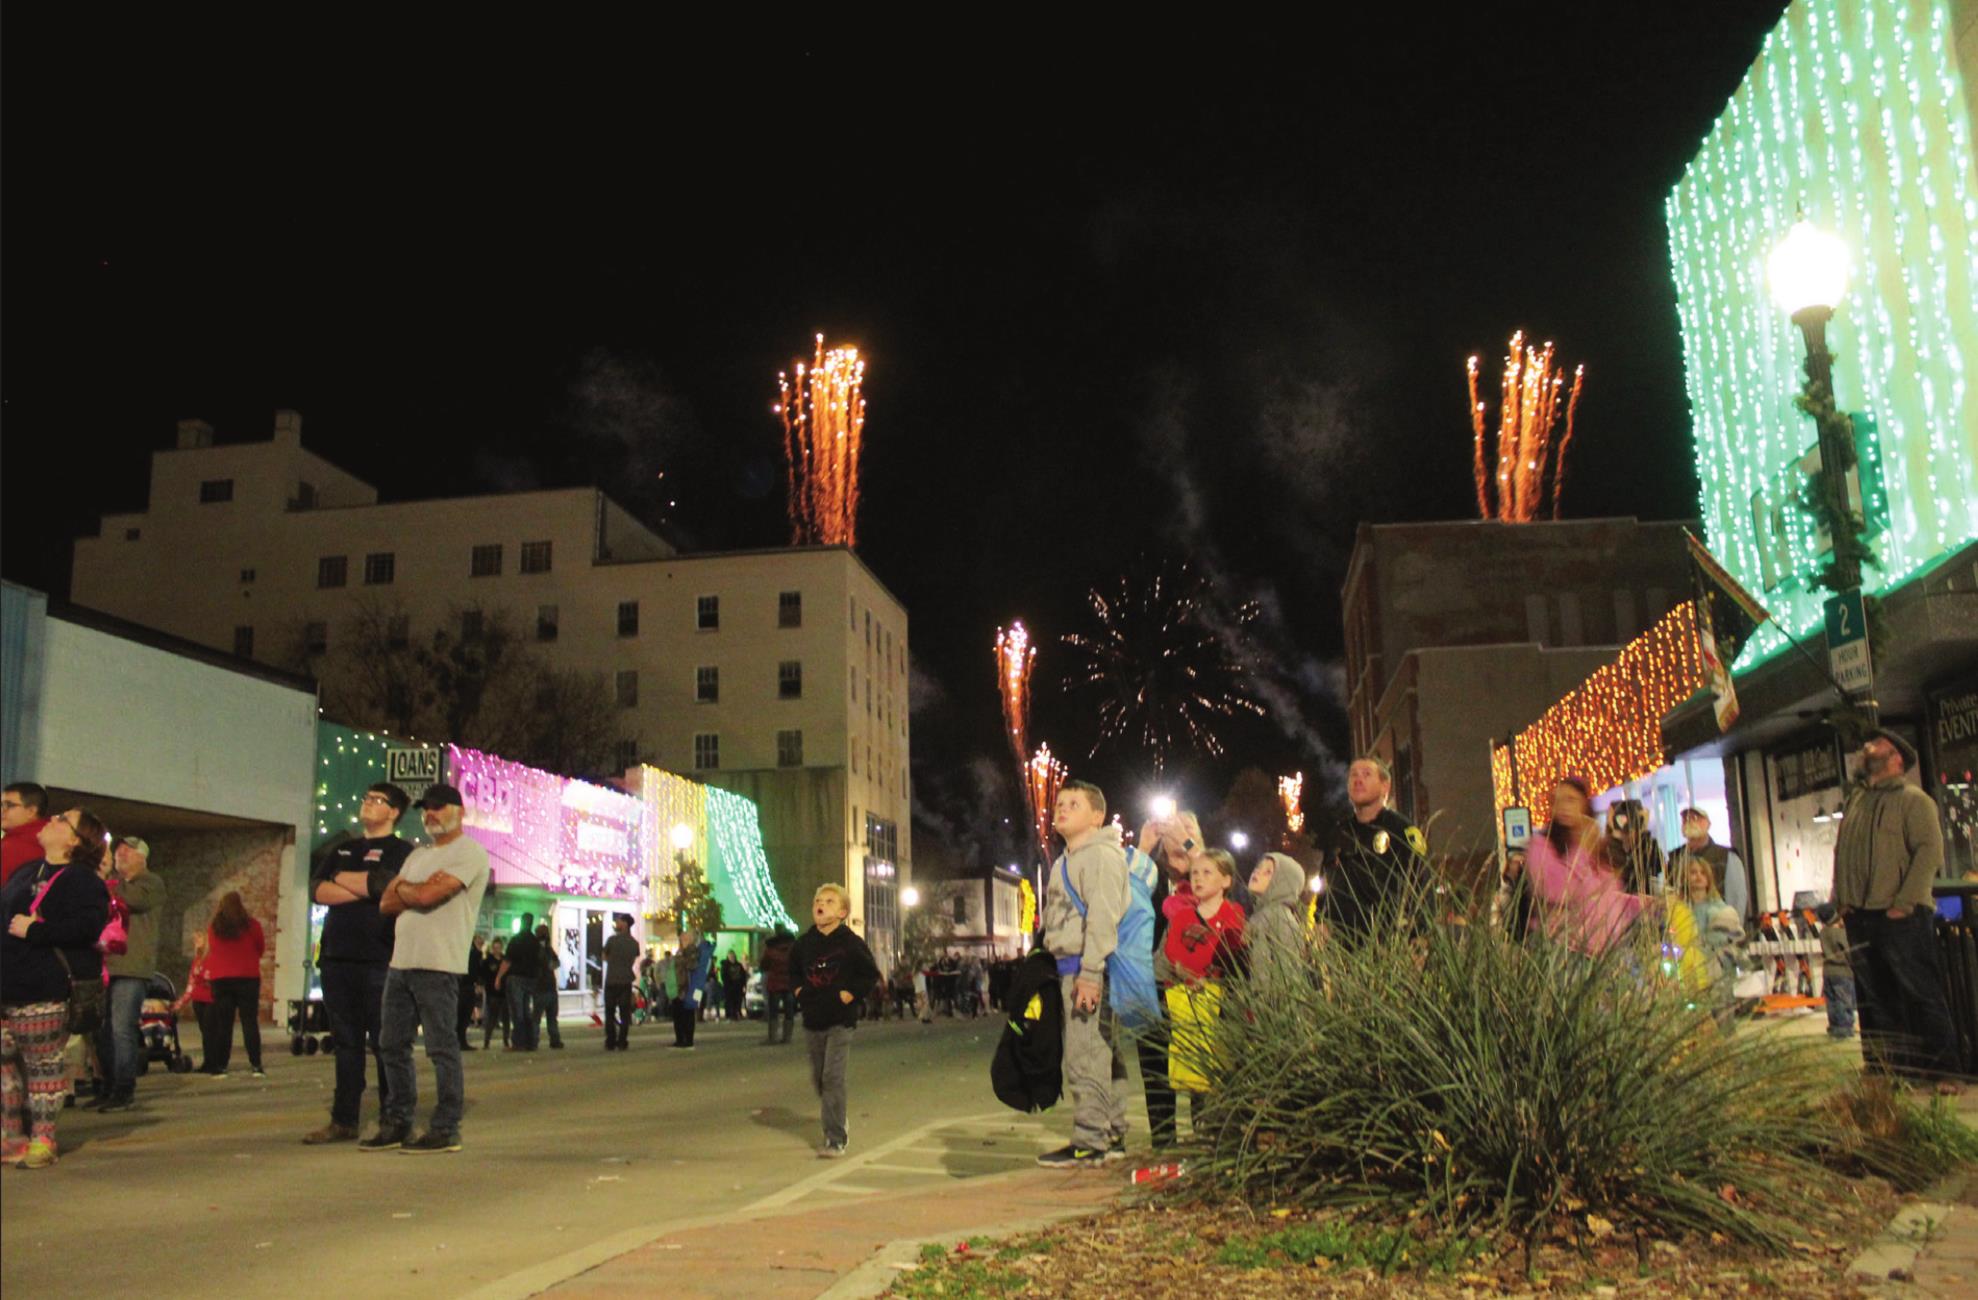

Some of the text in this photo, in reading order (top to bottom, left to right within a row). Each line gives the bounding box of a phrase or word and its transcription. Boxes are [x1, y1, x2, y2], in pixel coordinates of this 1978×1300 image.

[1838, 603, 1851, 636] 2
[1838, 645, 1859, 664] HOUR
[1836, 663, 1868, 685] PARKING
[390, 750, 436, 782] LOANS
[459, 771, 513, 816] CBD
